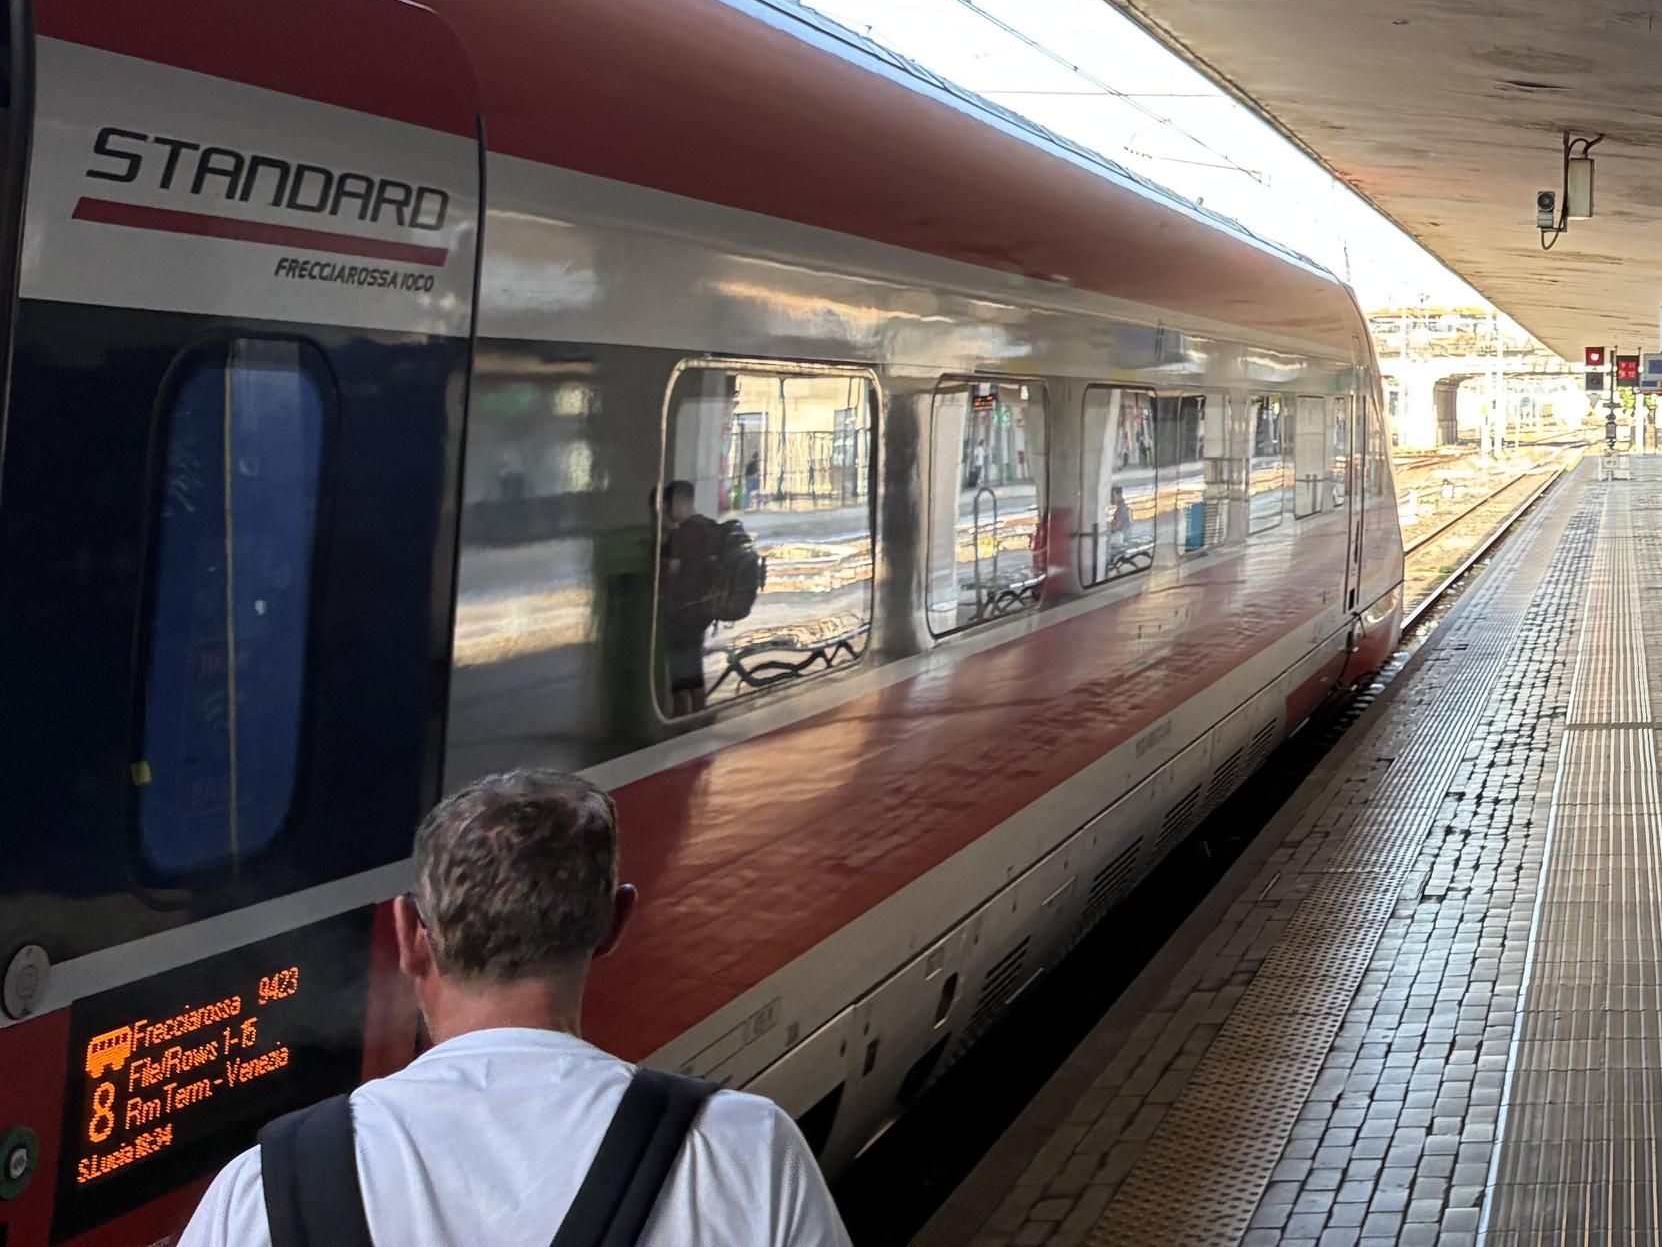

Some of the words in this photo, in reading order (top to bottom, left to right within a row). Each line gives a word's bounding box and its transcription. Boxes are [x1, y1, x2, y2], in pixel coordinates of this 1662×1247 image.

[86, 126, 450, 231] STANDARD
[274, 257, 398, 289] FRECCIAROSSA
[88, 1081, 116, 1143] 8
[126, 1097, 161, 1130] Rm
